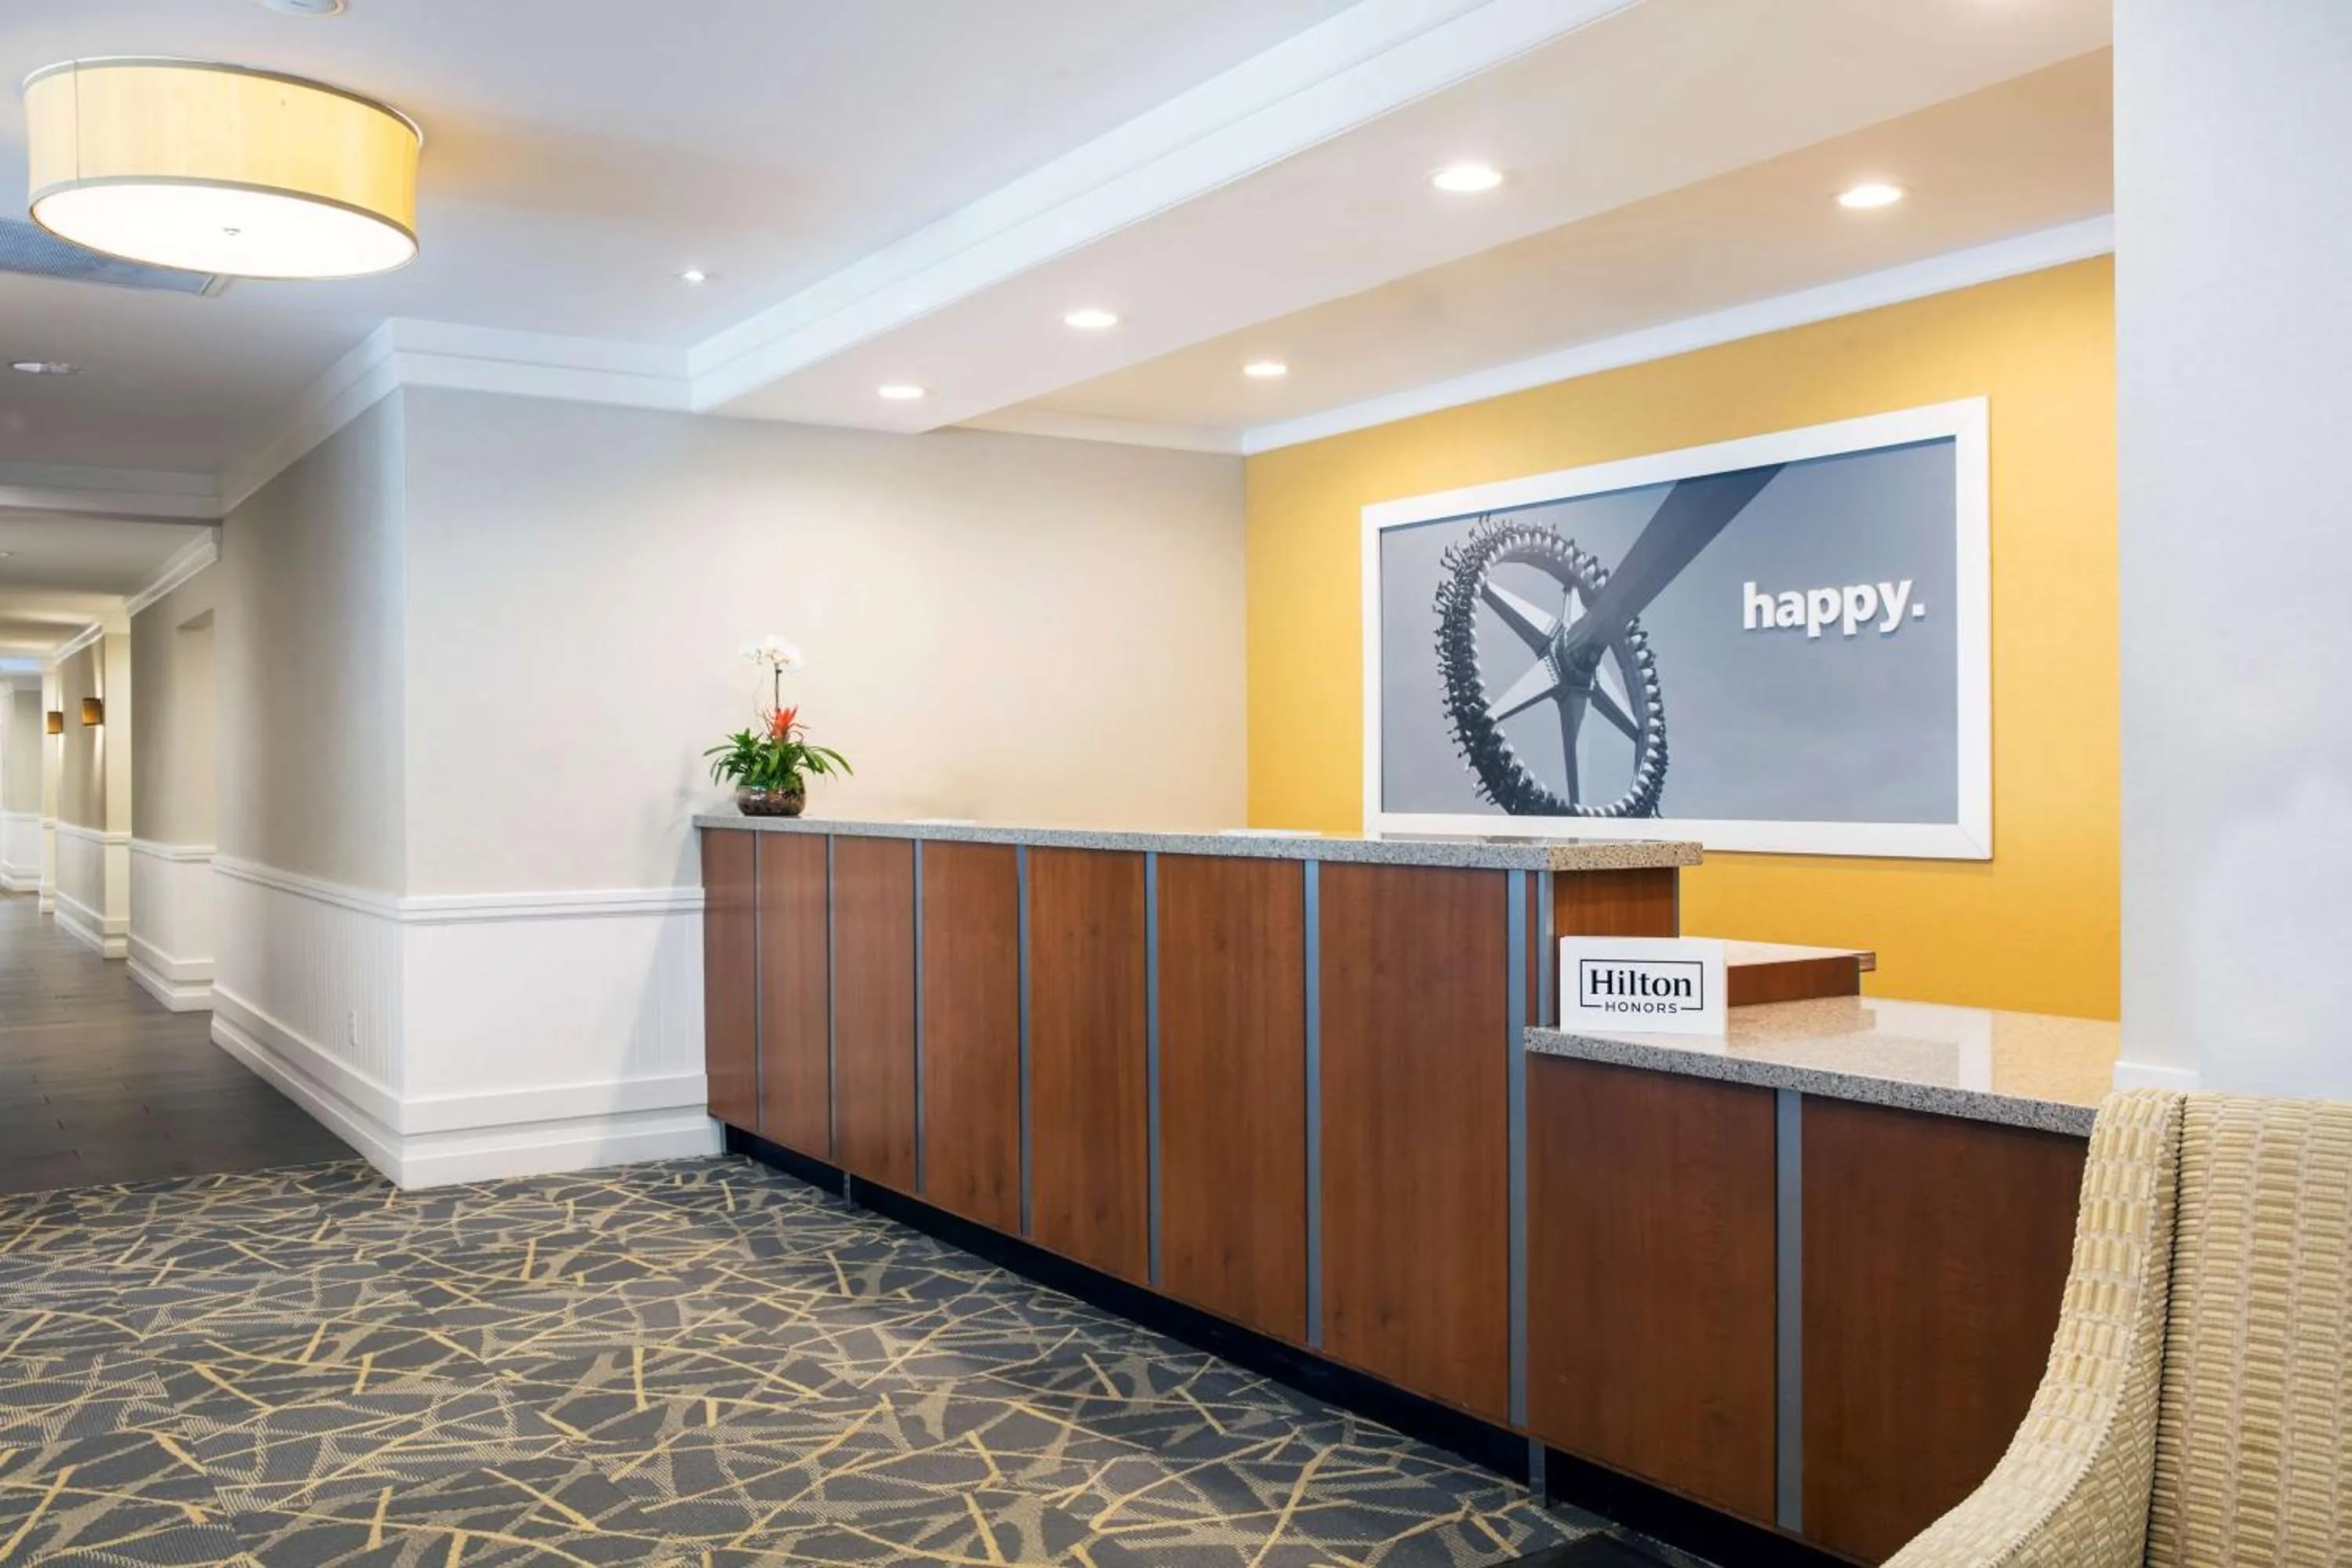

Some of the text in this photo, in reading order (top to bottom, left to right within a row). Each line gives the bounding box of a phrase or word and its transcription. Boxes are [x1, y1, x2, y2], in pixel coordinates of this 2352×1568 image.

[1743, 579, 1926, 637] happy.
[1590, 969, 1692, 996] Hilton
[1605, 1001, 1677, 1014] HONORS
